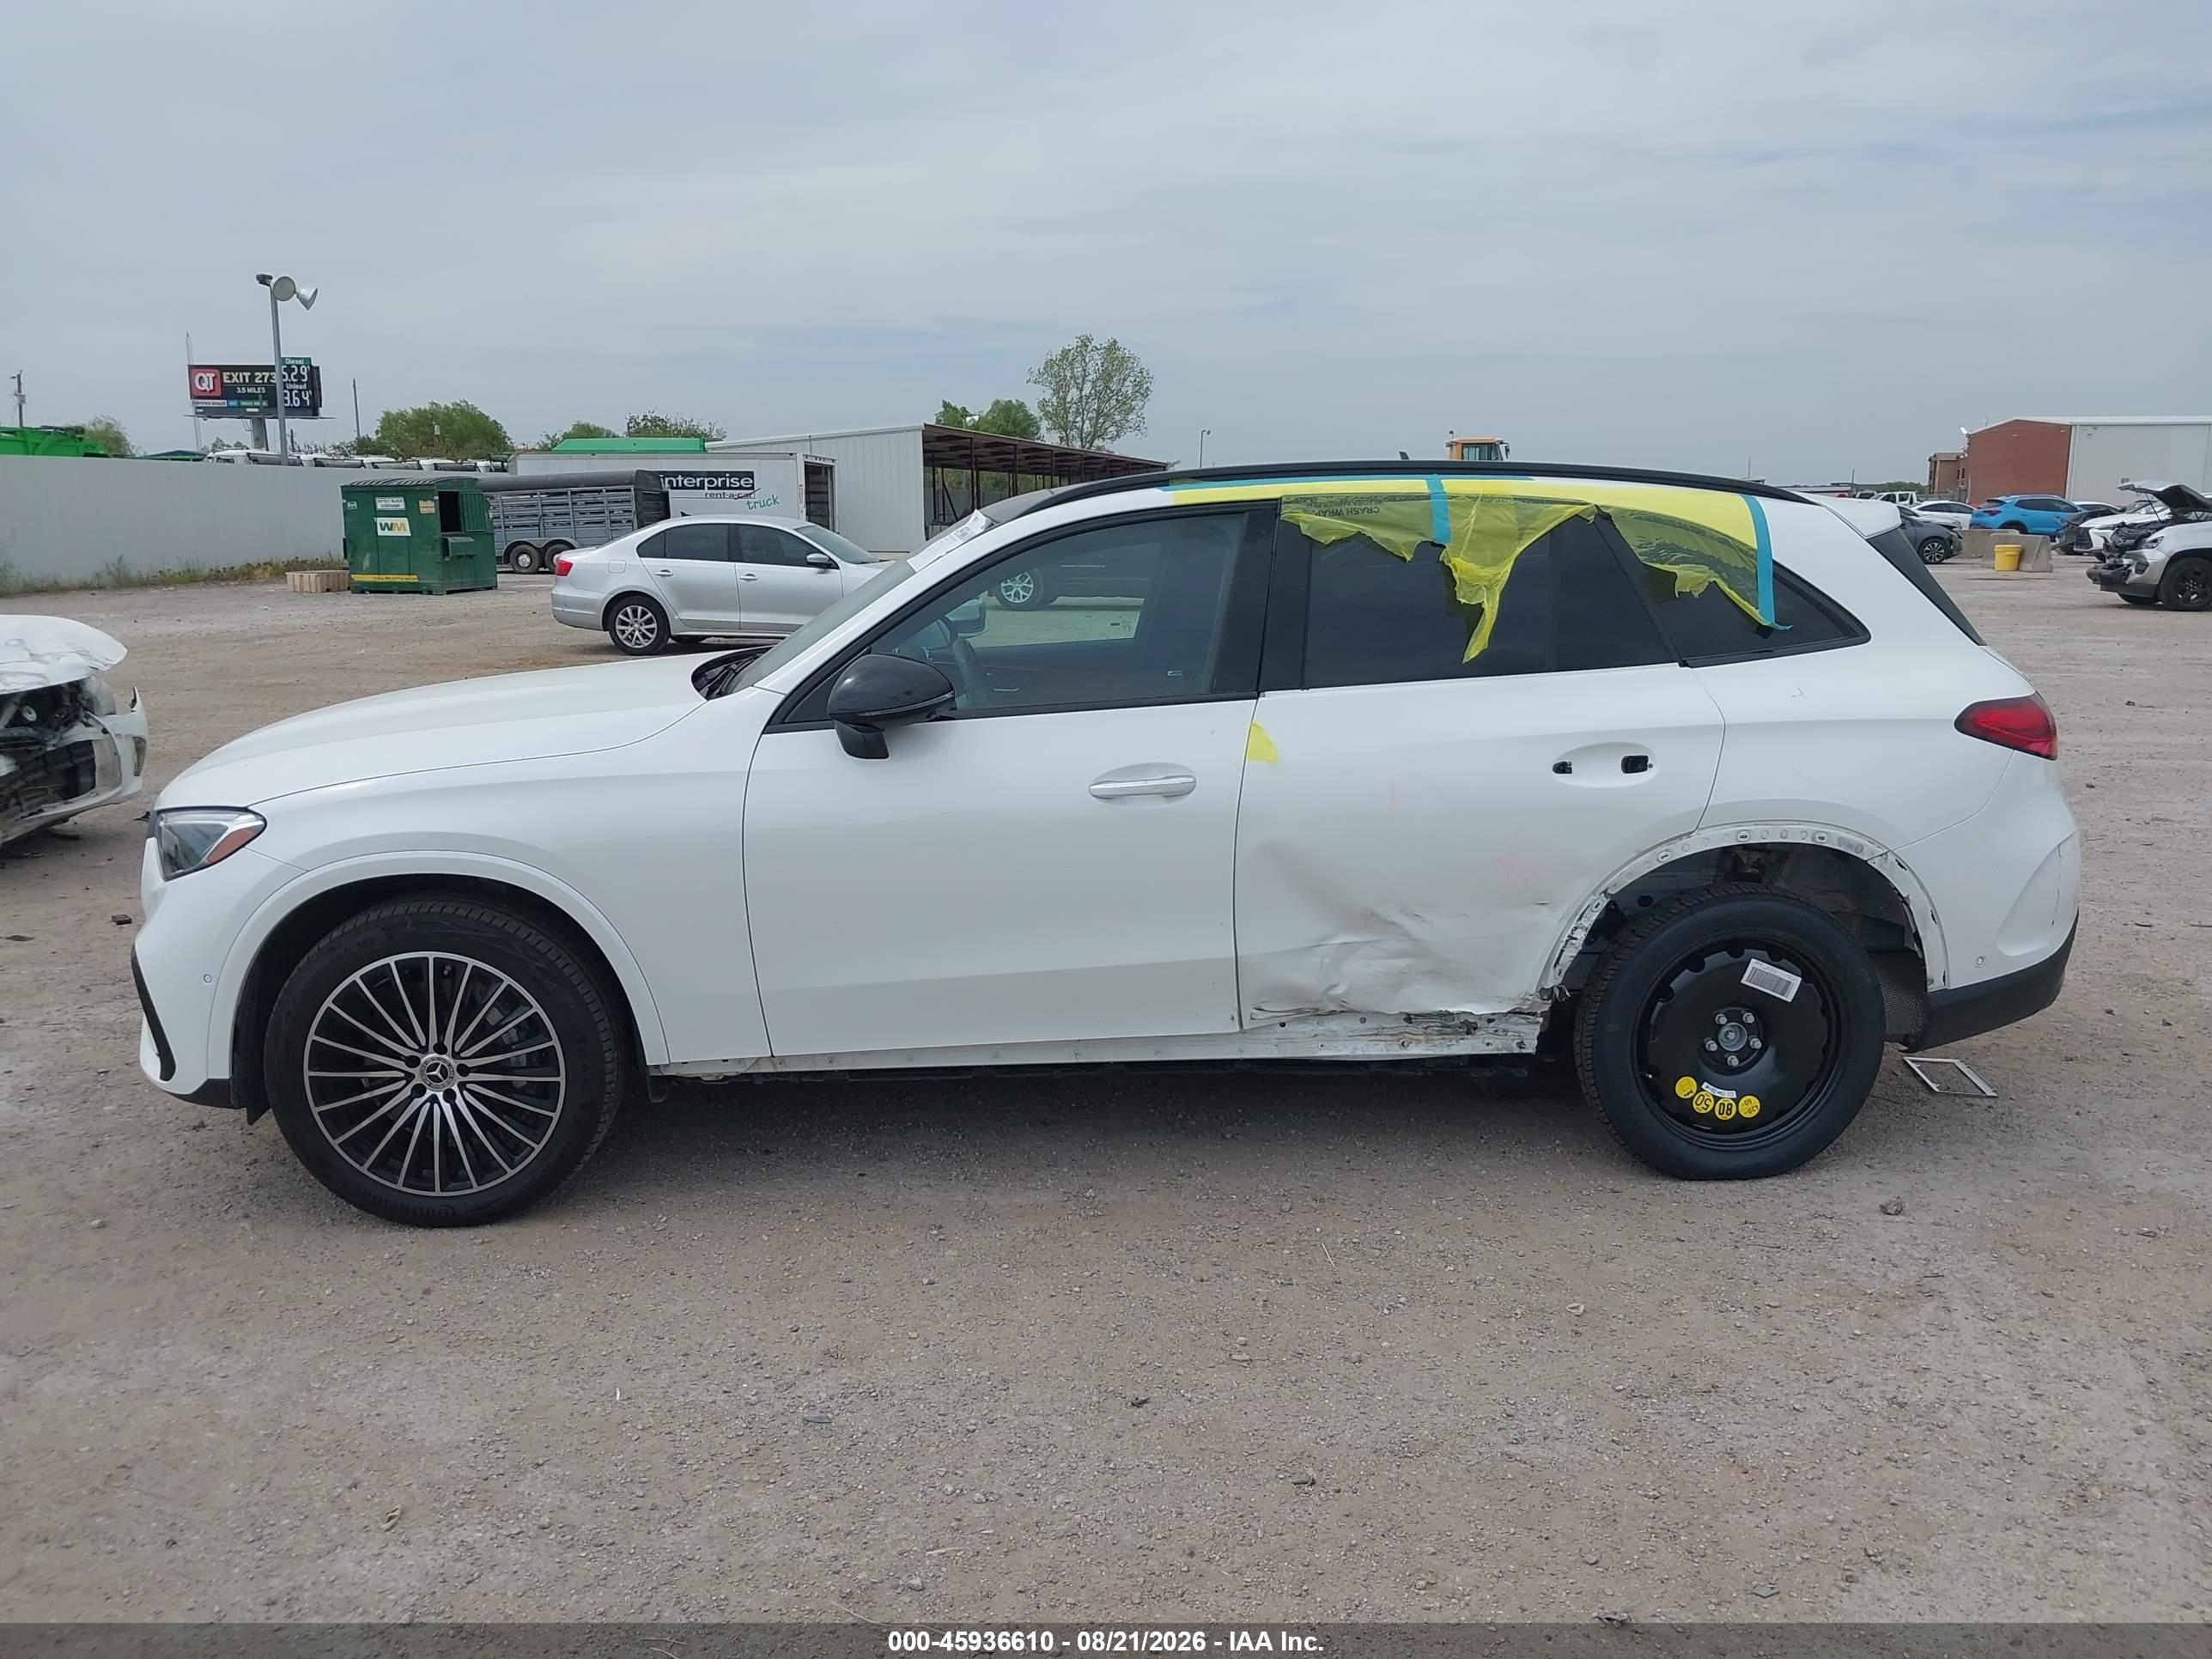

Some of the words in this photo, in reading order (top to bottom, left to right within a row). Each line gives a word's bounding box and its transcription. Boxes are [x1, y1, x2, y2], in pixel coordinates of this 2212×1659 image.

[194, 373, 216, 392] QT
[222, 372, 251, 383] EXIT
[254, 372, 276, 383] 273
[660, 474, 754, 490] nterprise
[745, 495, 780, 510] truck
[1346, 506, 1380, 515] CRASH
[379, 522, 407, 532] WM
[1694, 1093, 1712, 1111] 50
[1718, 1102, 1733, 1115] 80
